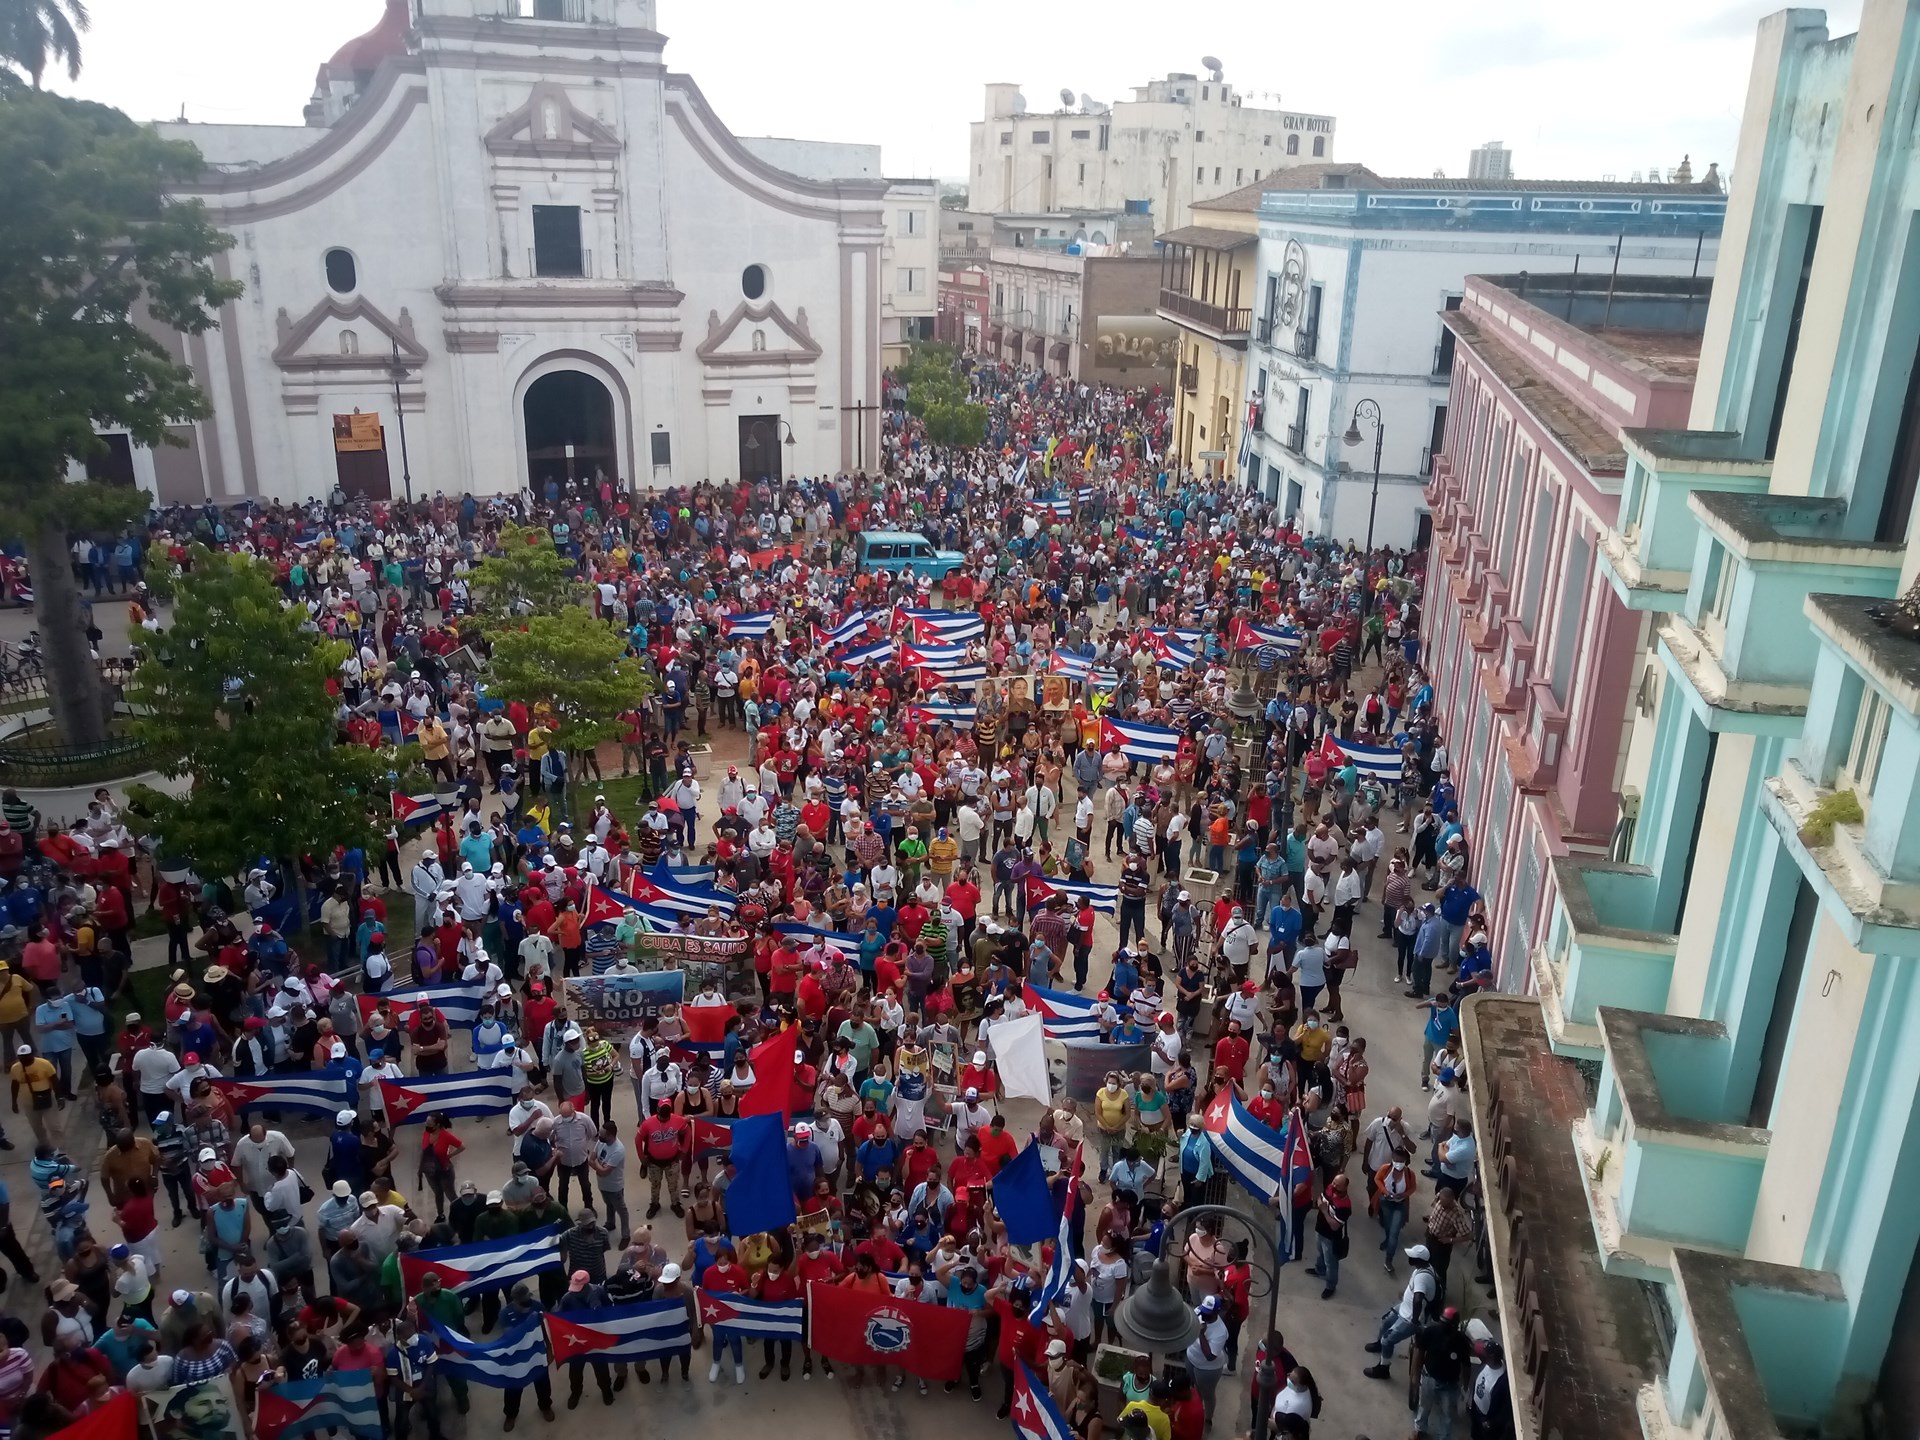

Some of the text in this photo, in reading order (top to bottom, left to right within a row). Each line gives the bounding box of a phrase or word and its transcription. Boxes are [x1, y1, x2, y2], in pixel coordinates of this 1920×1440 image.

[1283, 116, 1331, 133] GRAN HOTEL
[640, 936, 681, 951] CUBA
[684, 938, 701, 953] ES
[703, 941, 748, 956] SALUD
[602, 989, 643, 1008] NO
